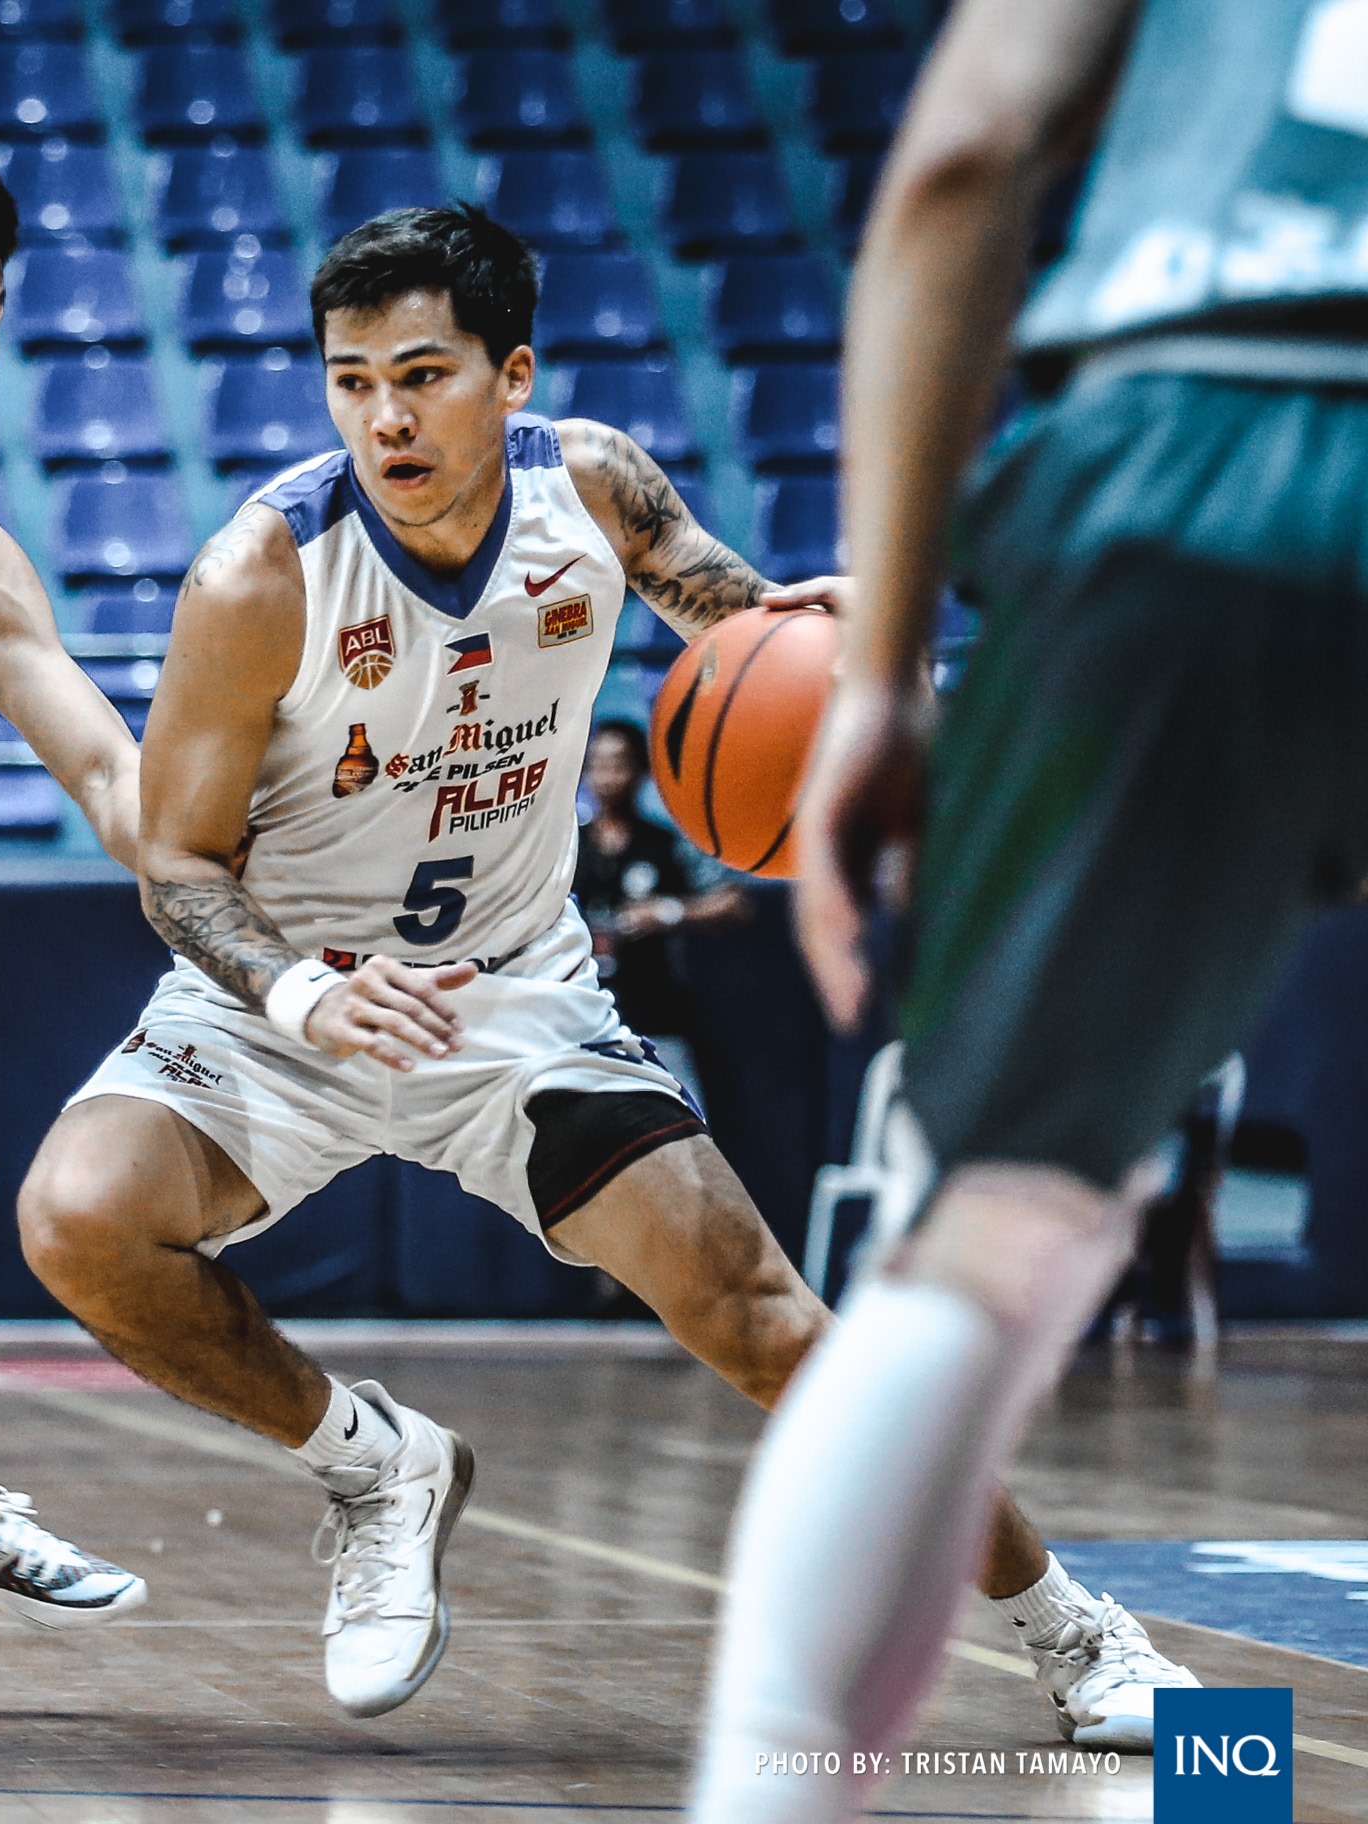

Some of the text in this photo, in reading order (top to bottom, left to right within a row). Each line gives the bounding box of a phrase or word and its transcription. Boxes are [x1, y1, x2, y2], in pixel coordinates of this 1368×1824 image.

[345, 627, 389, 657] ABL
[385, 697, 560, 779] San Miguel
[447, 752, 525, 780] PILSEN
[428, 758, 549, 843] ALAB
[393, 855, 474, 946] 5
